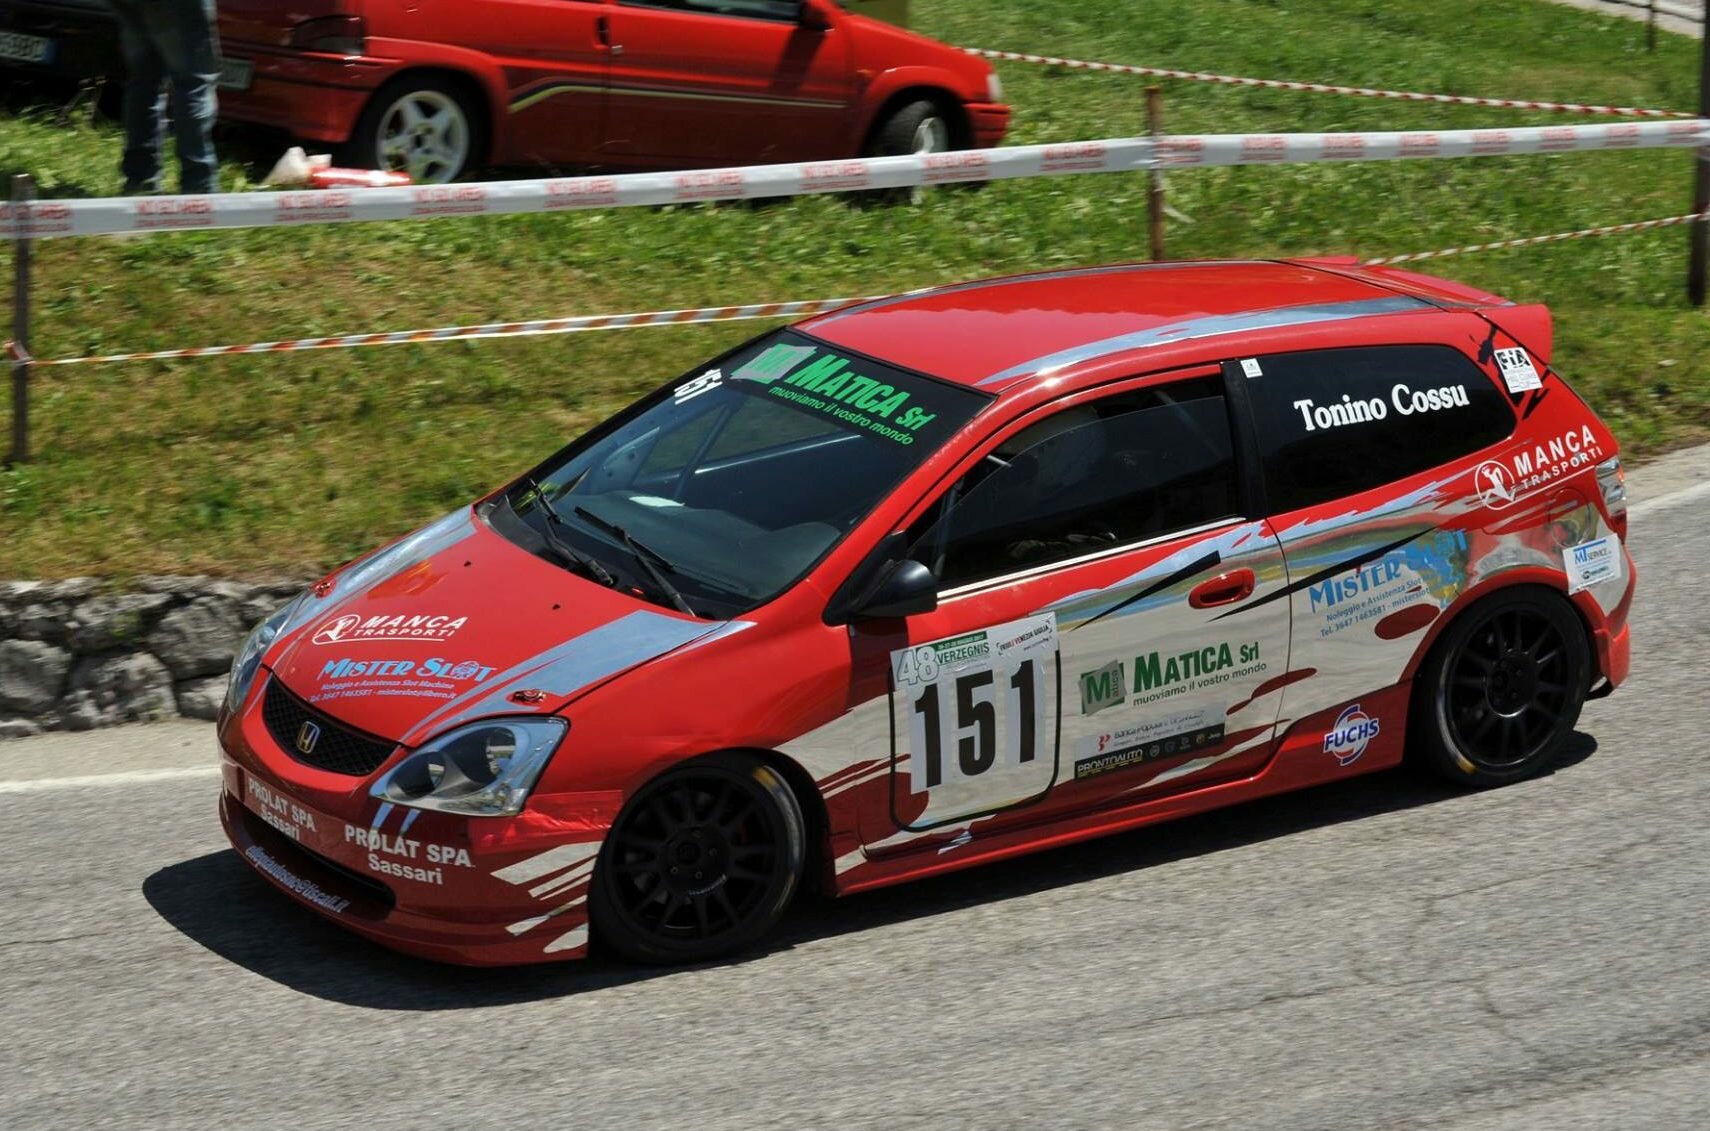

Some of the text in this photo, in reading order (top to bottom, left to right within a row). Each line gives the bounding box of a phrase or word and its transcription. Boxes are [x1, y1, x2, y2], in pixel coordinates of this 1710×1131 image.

[784, 354, 936, 430] MATICA Srl
[1293, 383, 1471, 431] Tonino Cossu
[768, 386, 914, 446] muoviamo il vostro mondo
[1513, 424, 1597, 478] MANCA
[1521, 446, 1603, 490] TRASPORTI
[1308, 558, 1402, 614] MISTER
[354, 628, 455, 637] TRASPORTI
[361, 615, 468, 629] MANCA
[1326, 602, 1360, 623] Noleggio
[316, 657, 415, 681] MISTER
[897, 644, 940, 686] 48
[936, 642, 990, 664] VERZEGNIS
[1132, 641, 1260, 694] MATICA Srl
[1132, 661, 1267, 707] muoviamo il vostro mondo
[914, 658, 1036, 788] 151
[1325, 720, 1379, 752] FUCHS
[249, 777, 316, 832] PROLAT SPA
[260, 804, 300, 840] Sassari
[344, 823, 475, 868] PROLAT SPA
[367, 854, 443, 885] Sassari
